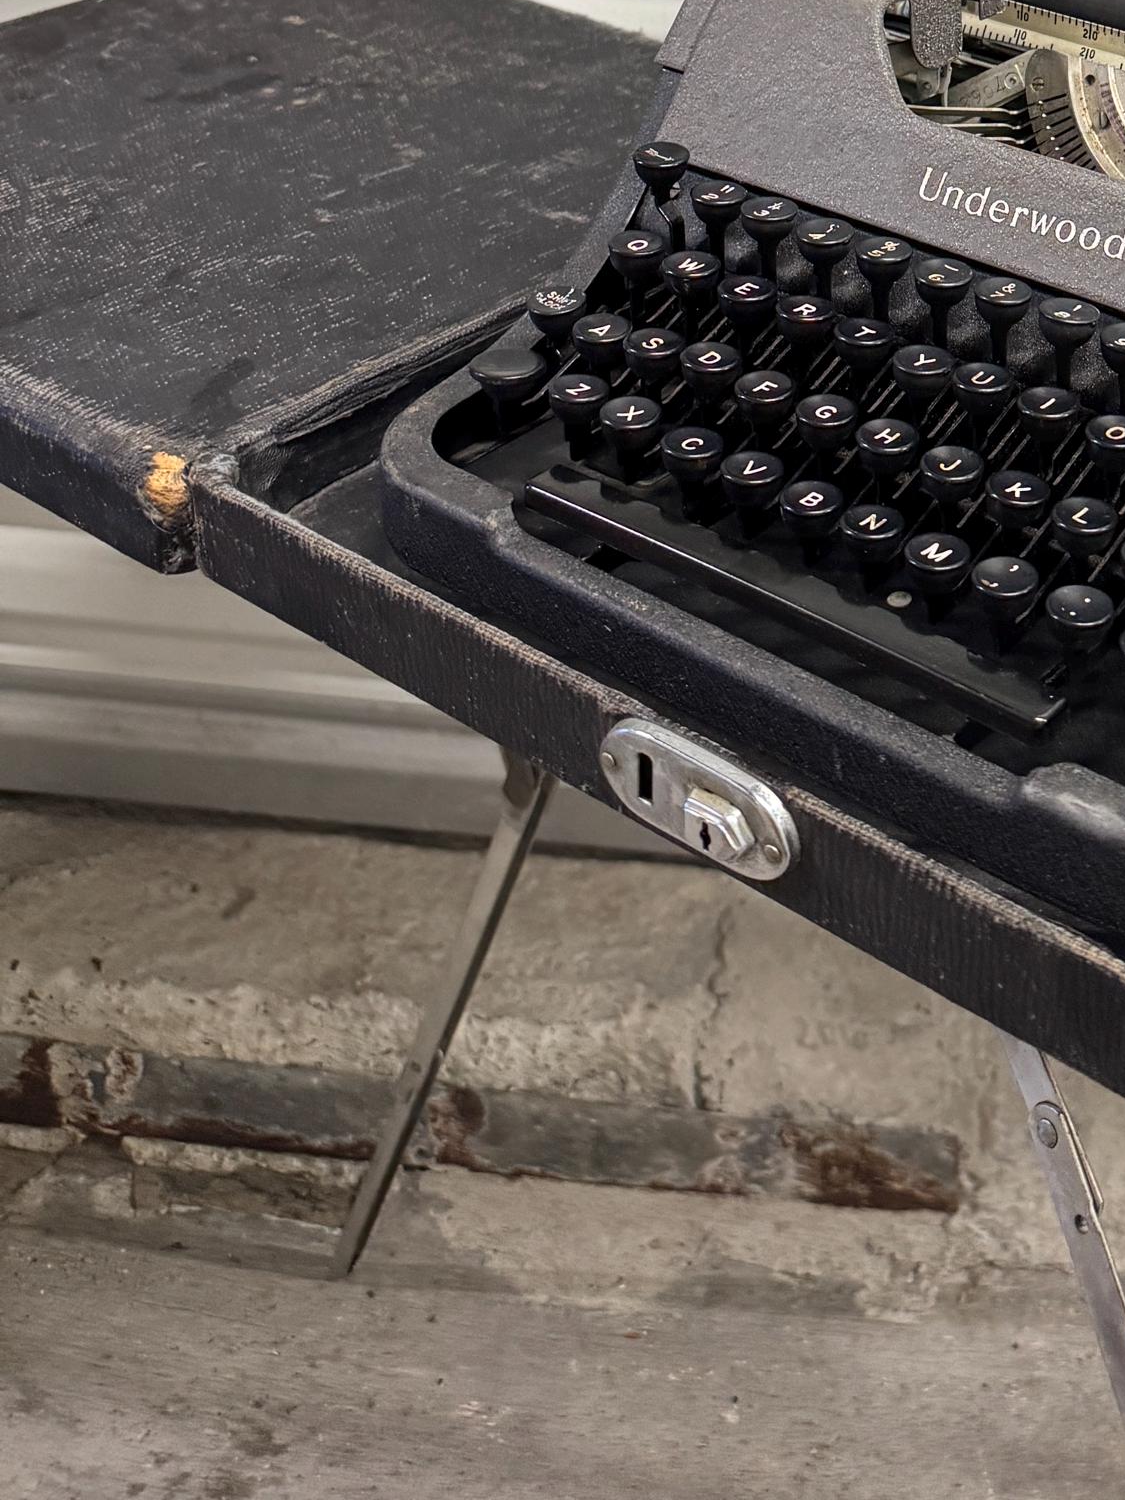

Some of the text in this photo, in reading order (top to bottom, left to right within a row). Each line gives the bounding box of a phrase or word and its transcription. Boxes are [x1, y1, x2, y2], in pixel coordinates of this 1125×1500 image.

[1082, 28, 1098, 41] 20
[1079, 46, 1096, 60] 20
[701, 193, 720, 201] 2
[753, 209, 770, 217] 3
[627, 239, 649, 251] Q
[867, 249, 886, 257] 5
[677, 257, 706, 272] W
[928, 273, 945, 281] 6
[736, 282, 760, 296] E
[792, 303, 817, 317] R
[587, 324, 611, 337] A
[854, 325, 877, 337] T
[642, 337, 664, 350] S
[697, 350, 722, 365] D
[913, 353, 937, 367] Y
[970, 370, 995, 385] U
[565, 382, 592, 396] Z
[752, 380, 779, 392] F
[1039, 397, 1056, 410] I
[616, 405, 645, 422] X
[814, 405, 838, 420] G
[873, 428, 901, 445] H
[681, 437, 704, 451] C
[742, 459, 768, 475] V
[939, 459, 962, 471] J
[1004, 481, 1032, 498] K
[798, 491, 824, 507] B
[858, 513, 888, 531] N
[1071, 506, 1089, 525] L
[920, 542, 953, 563] M
